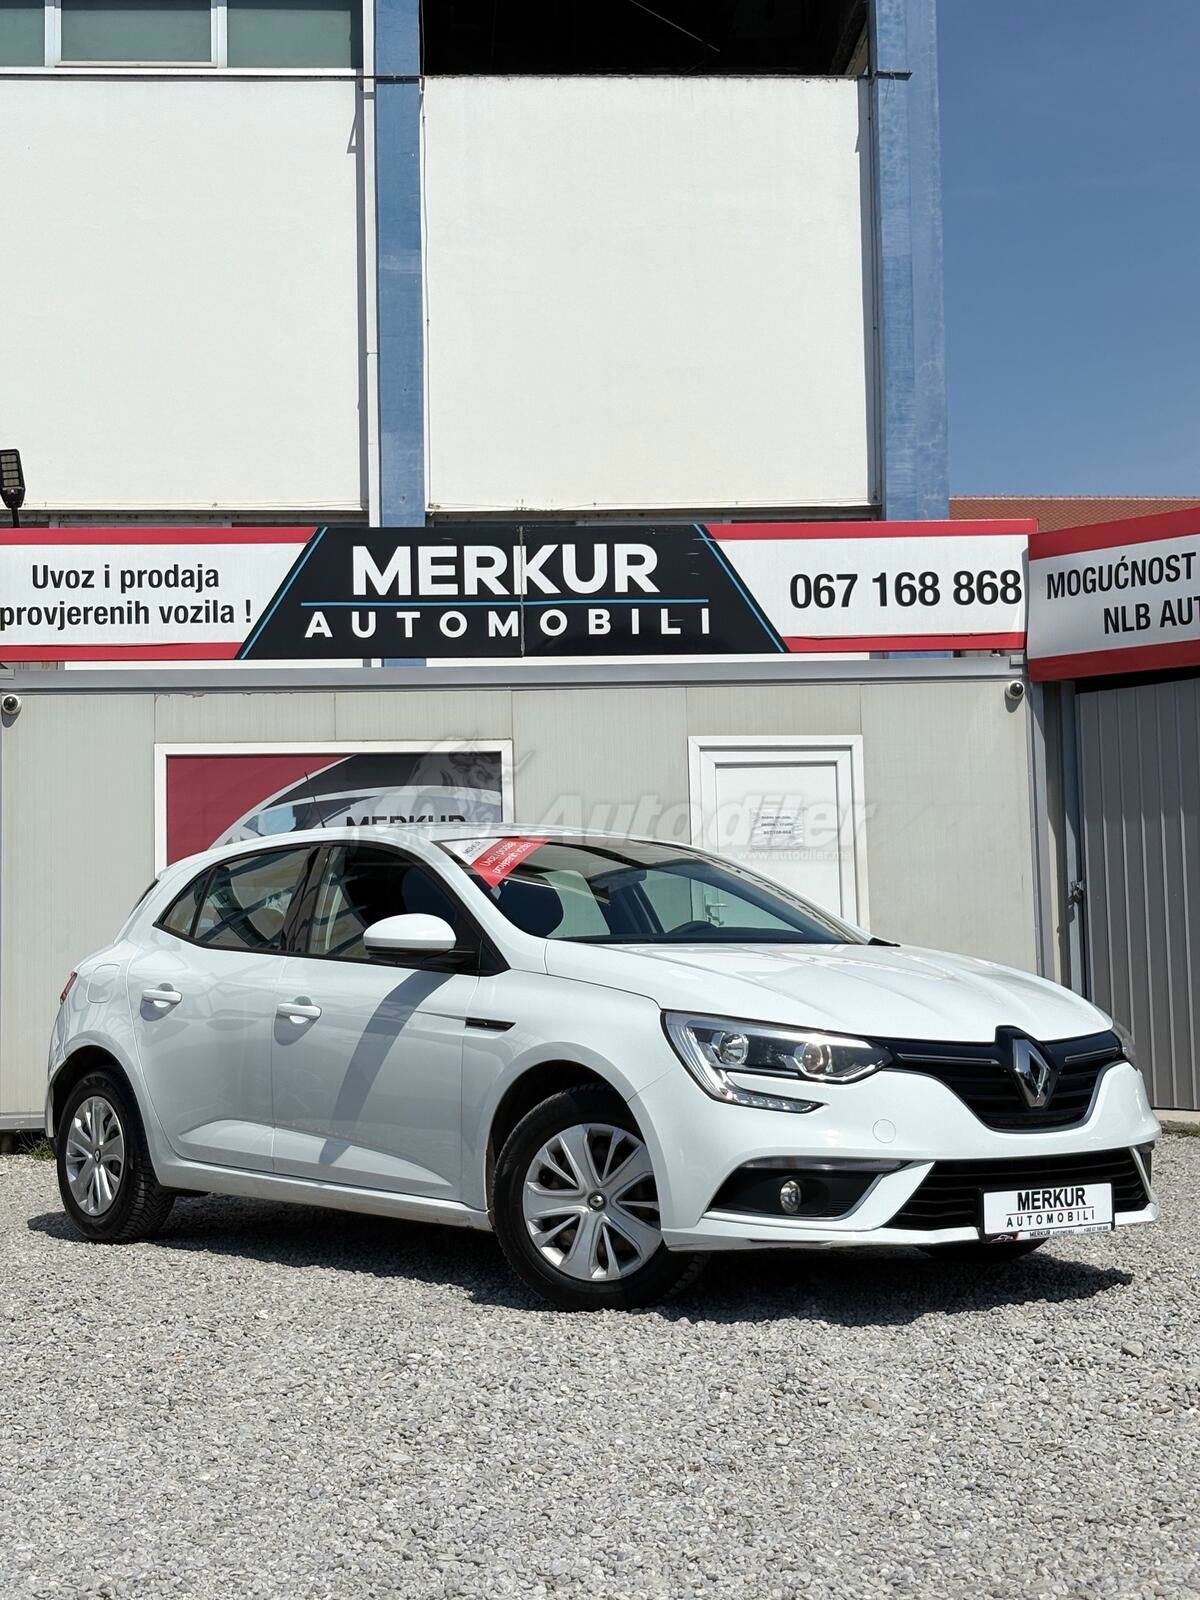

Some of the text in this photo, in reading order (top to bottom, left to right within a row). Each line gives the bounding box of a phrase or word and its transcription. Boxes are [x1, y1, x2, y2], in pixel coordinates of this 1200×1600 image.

[32, 564, 220, 594] Uvoz i prodaja
[352, 543, 660, 595] MERKUR
[1046, 552, 1197, 600] MOGUĆNOST
[789, 570, 1023, 609] 067 168 868
[0, 600, 149, 631] provjerenih
[159, 600, 235, 624] vozila
[305, 608, 710, 638] AUTOMOBILI
[1103, 603, 1151, 635] NLB
[1017, 1187, 1087, 1212] MERKUR
[1006, 1209, 1095, 1228] AUTOMOBILI
